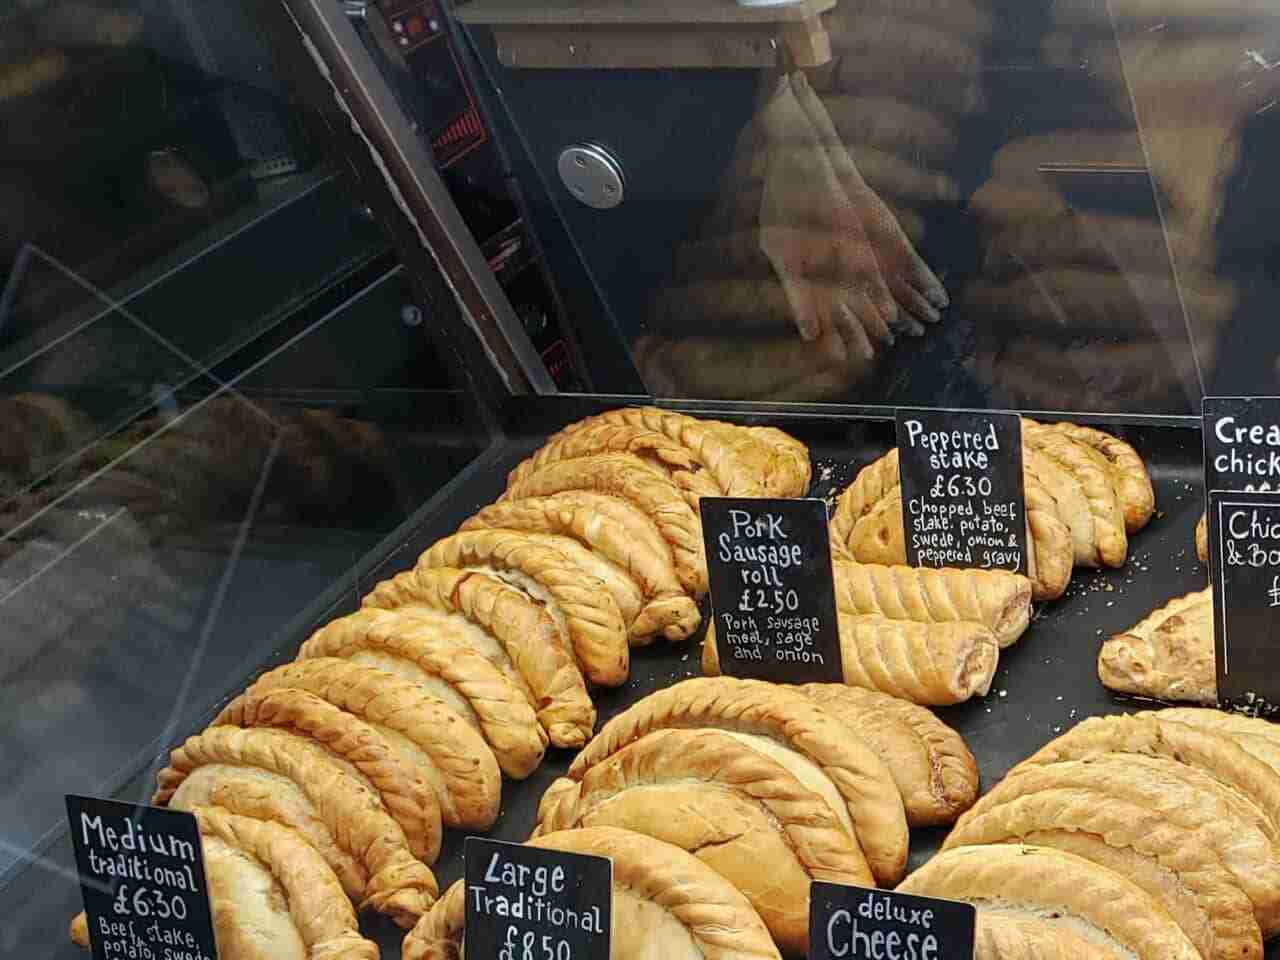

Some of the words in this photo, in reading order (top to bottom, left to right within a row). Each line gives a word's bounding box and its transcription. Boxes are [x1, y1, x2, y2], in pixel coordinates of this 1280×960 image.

[904, 420, 999, 452] Peppered
[929, 449, 988, 469] stake
[930, 474, 992, 498] £6.30
[909, 496, 973, 518] Chopped
[983, 500, 1016, 520] beef
[719, 533, 801, 568] Sausage
[968, 533, 1004, 547] onion
[1008, 534, 1019, 547] &
[918, 547, 972, 567] peppered
[979, 550, 1020, 572] gravy
[741, 564, 783, 586] roll
[738, 589, 799, 614] £2.50
[721, 613, 758, 630] Pork
[734, 645, 762, 660] and
[776, 649, 824, 665] onion
[80, 812, 195, 862] Medium
[88, 848, 199, 892] traditional
[484, 852, 565, 896] Large
[113, 884, 187, 919] £6.30
[469, 886, 603, 933] Traditional
[858, 893, 934, 928] deluxe
[98, 916, 134, 943] Beef
